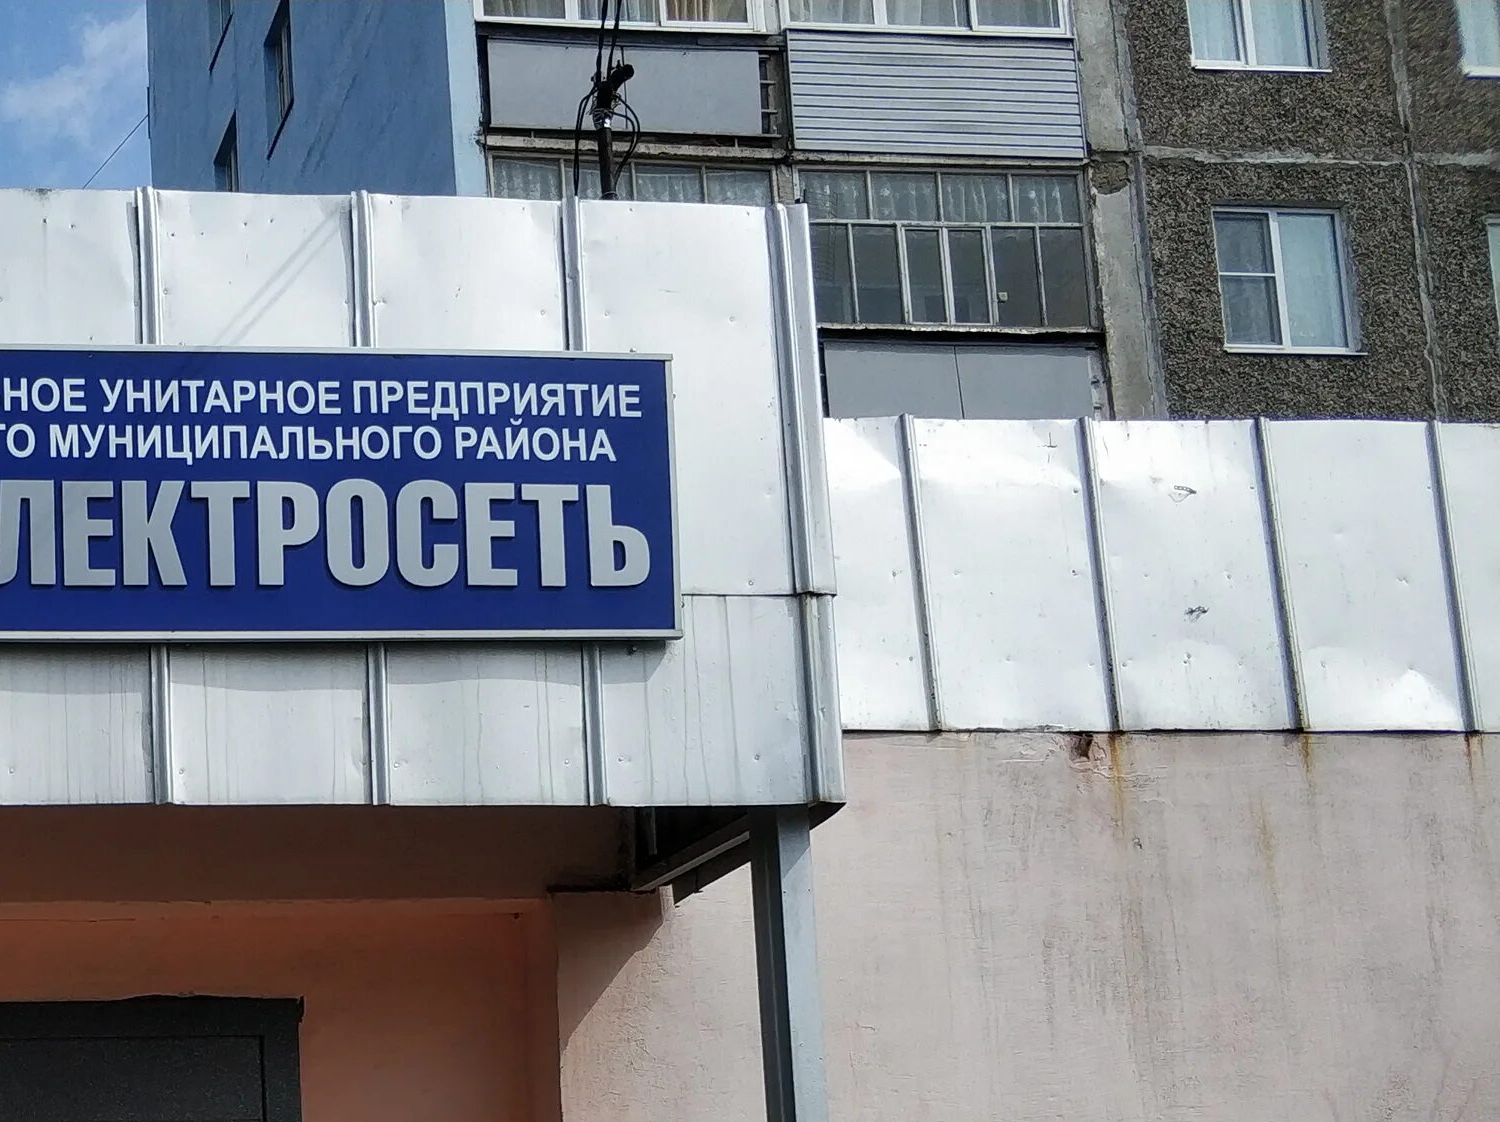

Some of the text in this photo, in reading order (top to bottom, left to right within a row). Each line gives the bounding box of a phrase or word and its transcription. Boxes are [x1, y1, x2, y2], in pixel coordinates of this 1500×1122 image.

[100, 379, 341, 414] УНИТАРНОЕ
[353, 381, 641, 425] ПРЕДПРИЯТИЕ
[50, 424, 441, 465] МУНИЦИПАЛЬНОГО
[454, 418, 616, 461] РАЙОНА
